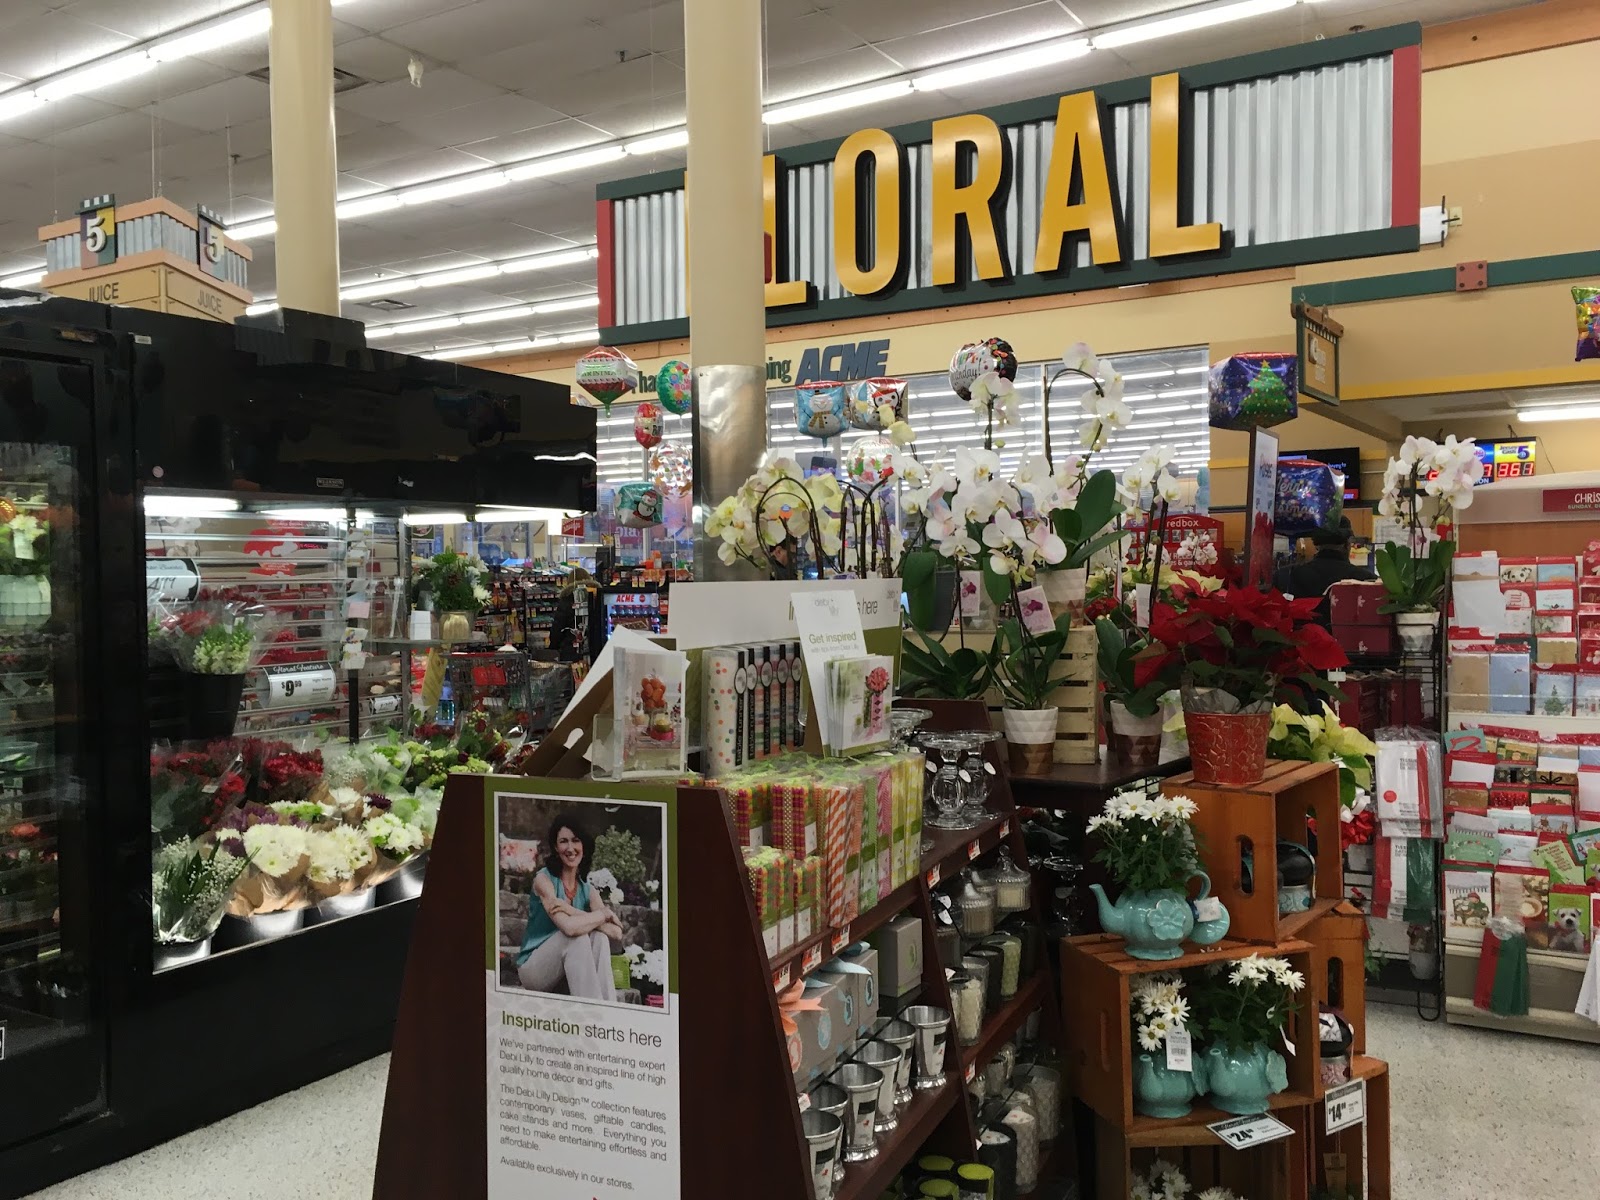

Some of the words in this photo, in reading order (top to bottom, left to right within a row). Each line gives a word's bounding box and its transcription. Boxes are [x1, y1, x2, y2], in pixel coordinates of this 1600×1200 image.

[684, 72, 1221, 317] LORAL
[86, 214, 107, 252] 5
[206, 230, 223, 263] 5
[86, 282, 119, 303] JUICE
[198, 290, 222, 315] JUICE
[795, 338, 890, 384] ACME
[1166, 519, 1199, 528] redbox
[616, 594, 634, 603] ACME
[861, 598, 878, 615] here
[809, 633, 825, 644] Get
[826, 632, 857, 644] inspired
[502, 1010, 580, 1035] Inspiration
[584, 1024, 625, 1043] starts
[629, 1028, 662, 1048] here
[499, 1037, 524, 1049] We've
[527, 1043, 565, 1056] partnered
[567, 1049, 584, 1058] with
[587, 1052, 636, 1068] entertaining
[638, 1059, 666, 1071] expert
[500, 1050, 518, 1061] Debi
[519, 1053, 533, 1065] Lilly
[536, 1057, 545, 1065] to
[546, 1059, 572, 1070] create
[573, 1064, 584, 1072] an
[586, 1064, 619, 1077] inspired
[620, 1069, 635, 1080] line
[637, 1072, 646, 1082] of
[647, 1073, 666, 1086] high
[500, 1064, 525, 1077] quality
[526, 1067, 550, 1080] home
[577, 1077, 593, 1087] and
[595, 1079, 615, 1090] gifts.
[500, 1083, 515, 1094] The
[516, 1086, 535, 1097] Debi
[535, 1090, 550, 1102] Lilly
[591, 1100, 631, 1114] collection
[632, 1105, 667, 1120] features
[500, 1098, 555, 1116] contemporary
[561, 1108, 587, 1121] vases,
[593, 1113, 624, 1126] giftable
[630, 1121, 666, 1135] candles,
[500, 1110, 519, 1121] cake
[522, 1114, 549, 1126] stands
[552, 1120, 568, 1130] and
[603, 1127, 647, 1146] Everything
[651, 1138, 667, 1148] you
[500, 1123, 520, 1134] need
[522, 1127, 531, 1136] to
[533, 1130, 556, 1141] make
[559, 1134, 607, 1152] entertaining
[609, 1142, 647, 1158] effortless
[650, 1151, 667, 1161] and
[500, 1136, 541, 1151] affordable.
[500, 1155, 535, 1171] Available
[536, 1164, 579, 1181] exclusively
[581, 1171, 589, 1181] in
[590, 1174, 604, 1184] our
[606, 1177, 635, 1190] stores.
